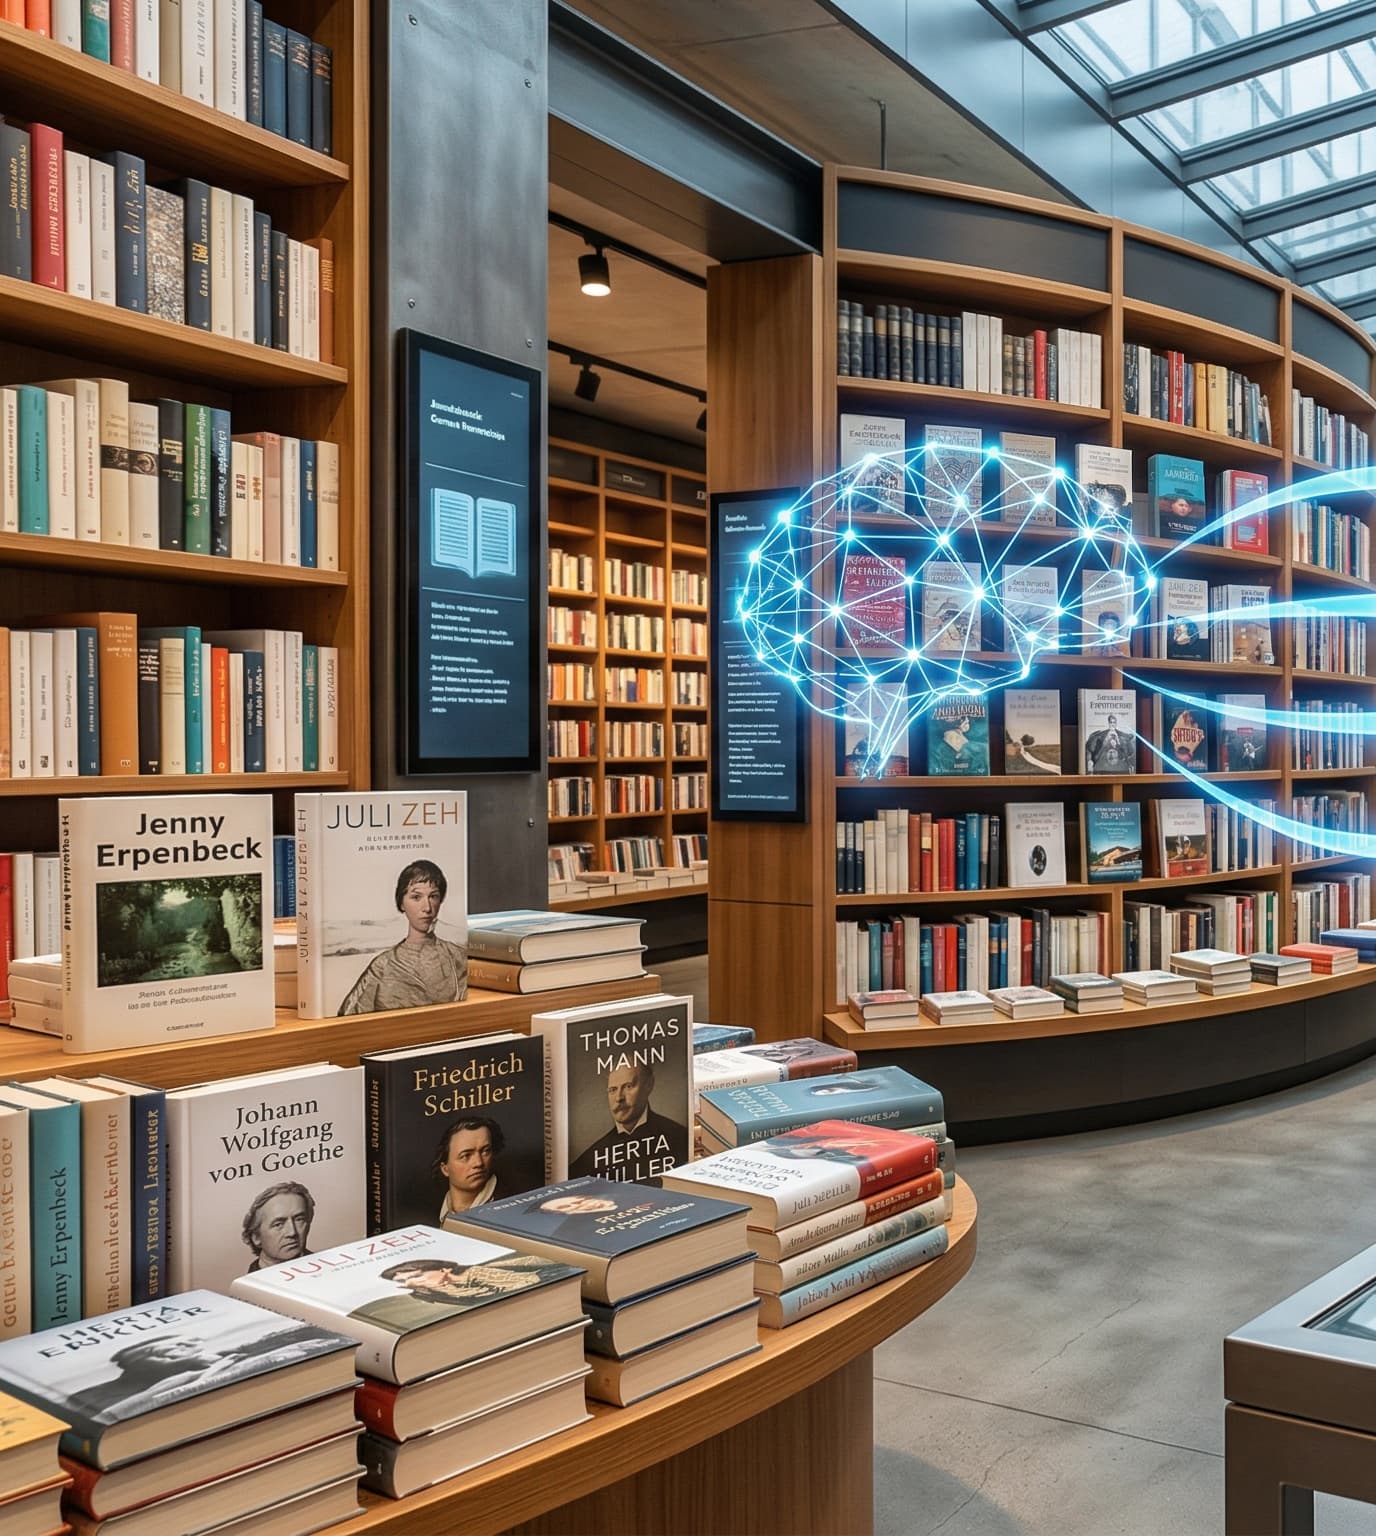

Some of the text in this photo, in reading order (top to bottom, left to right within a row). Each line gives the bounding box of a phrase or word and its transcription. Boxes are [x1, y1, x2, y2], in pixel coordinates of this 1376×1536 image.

[136, 813, 225, 838] Jenny
[326, 800, 458, 830] JULI ZEH
[96, 837, 263, 871] Erpenbeck
[579, 1018, 680, 1052] THOMAS
[413, 1052, 524, 1092] Friedrich
[596, 1045, 665, 1075] MANN
[236, 1099, 319, 1129] Johann
[424, 1083, 516, 1117] Schiller
[220, 1121, 334, 1155] Wolfgang
[594, 1134, 671, 1169] HERTA
[209, 1143, 344, 1184] von Goethe
[279, 1229, 432, 1282] JULI ZEH
[57, 1305, 180, 1341] HERTA
